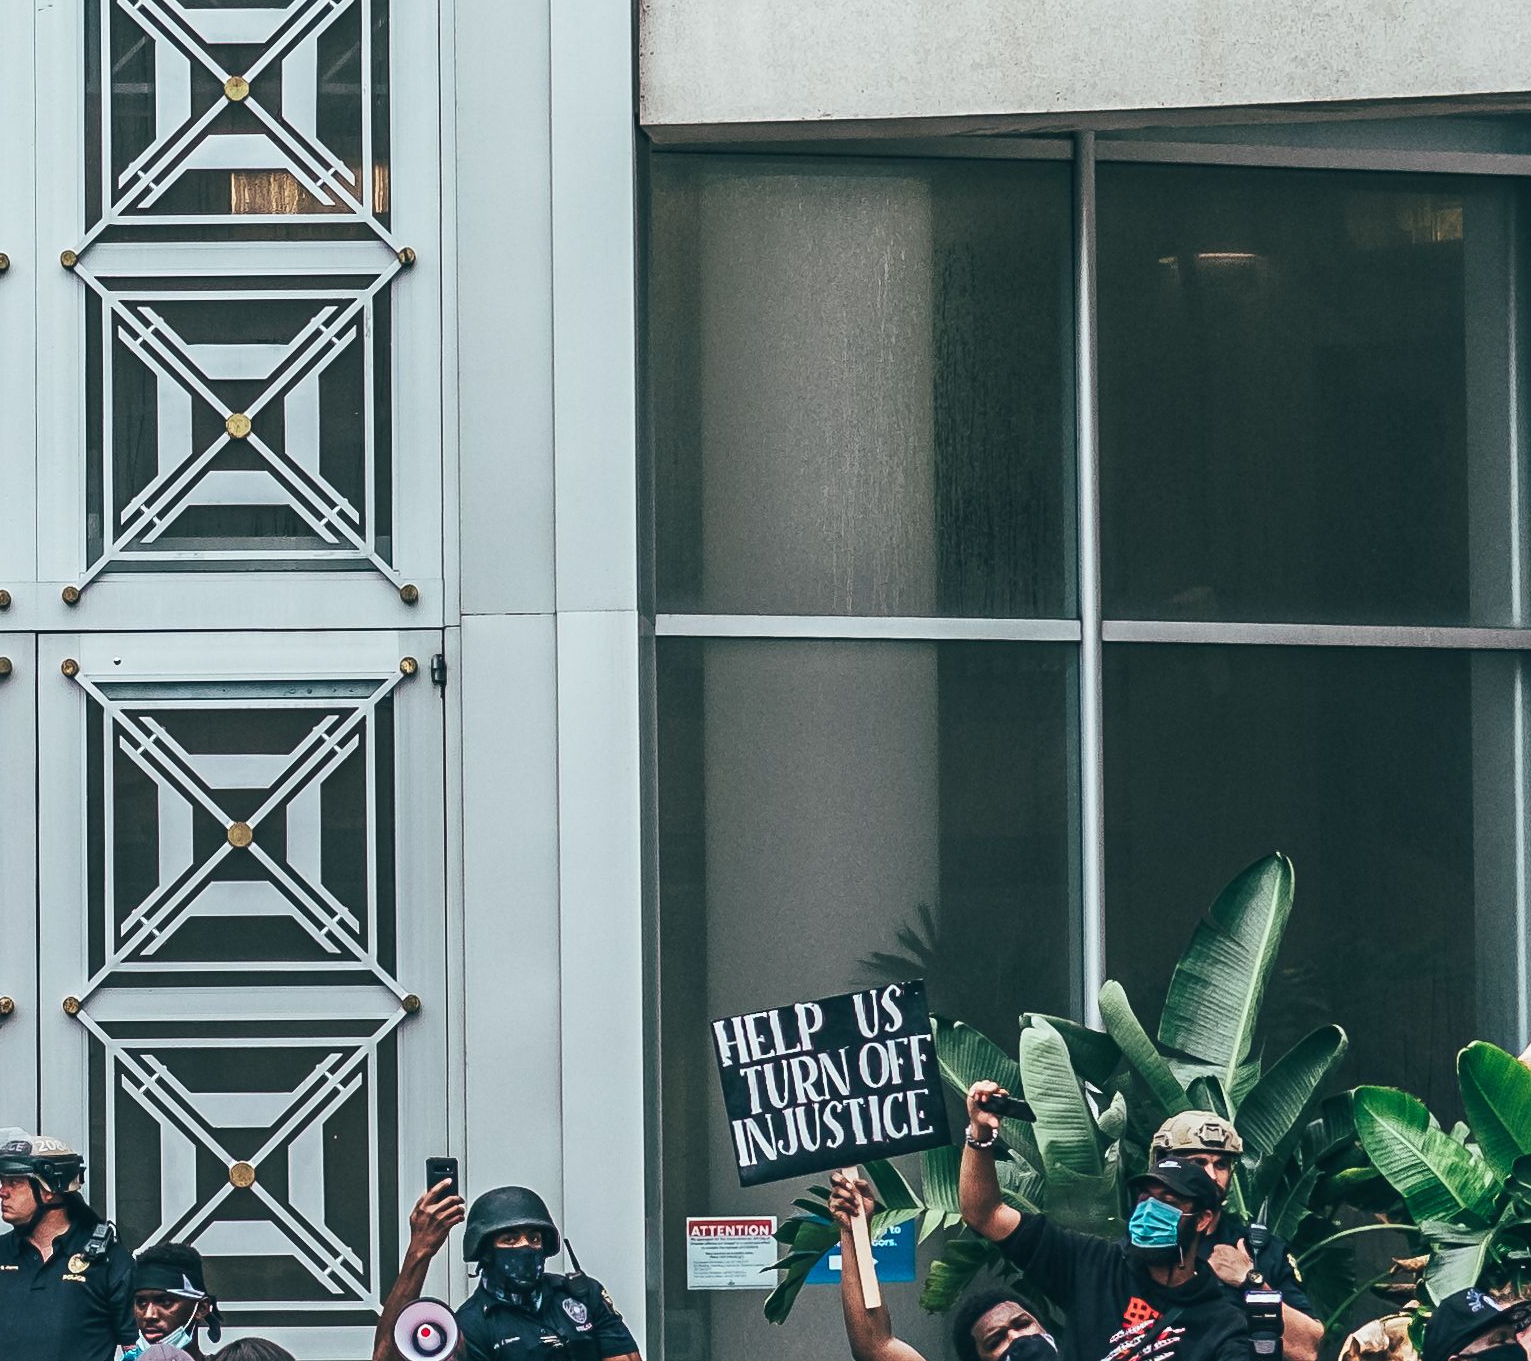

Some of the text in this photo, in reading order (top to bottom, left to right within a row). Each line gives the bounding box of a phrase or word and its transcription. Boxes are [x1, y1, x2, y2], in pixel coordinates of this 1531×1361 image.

[712, 984, 904, 1067] HELP US
[740, 1033, 933, 1116] TURN OFF
[732, 1089, 935, 1168] INJUSTICE
[691, 1225, 770, 1237] ATTENTION
